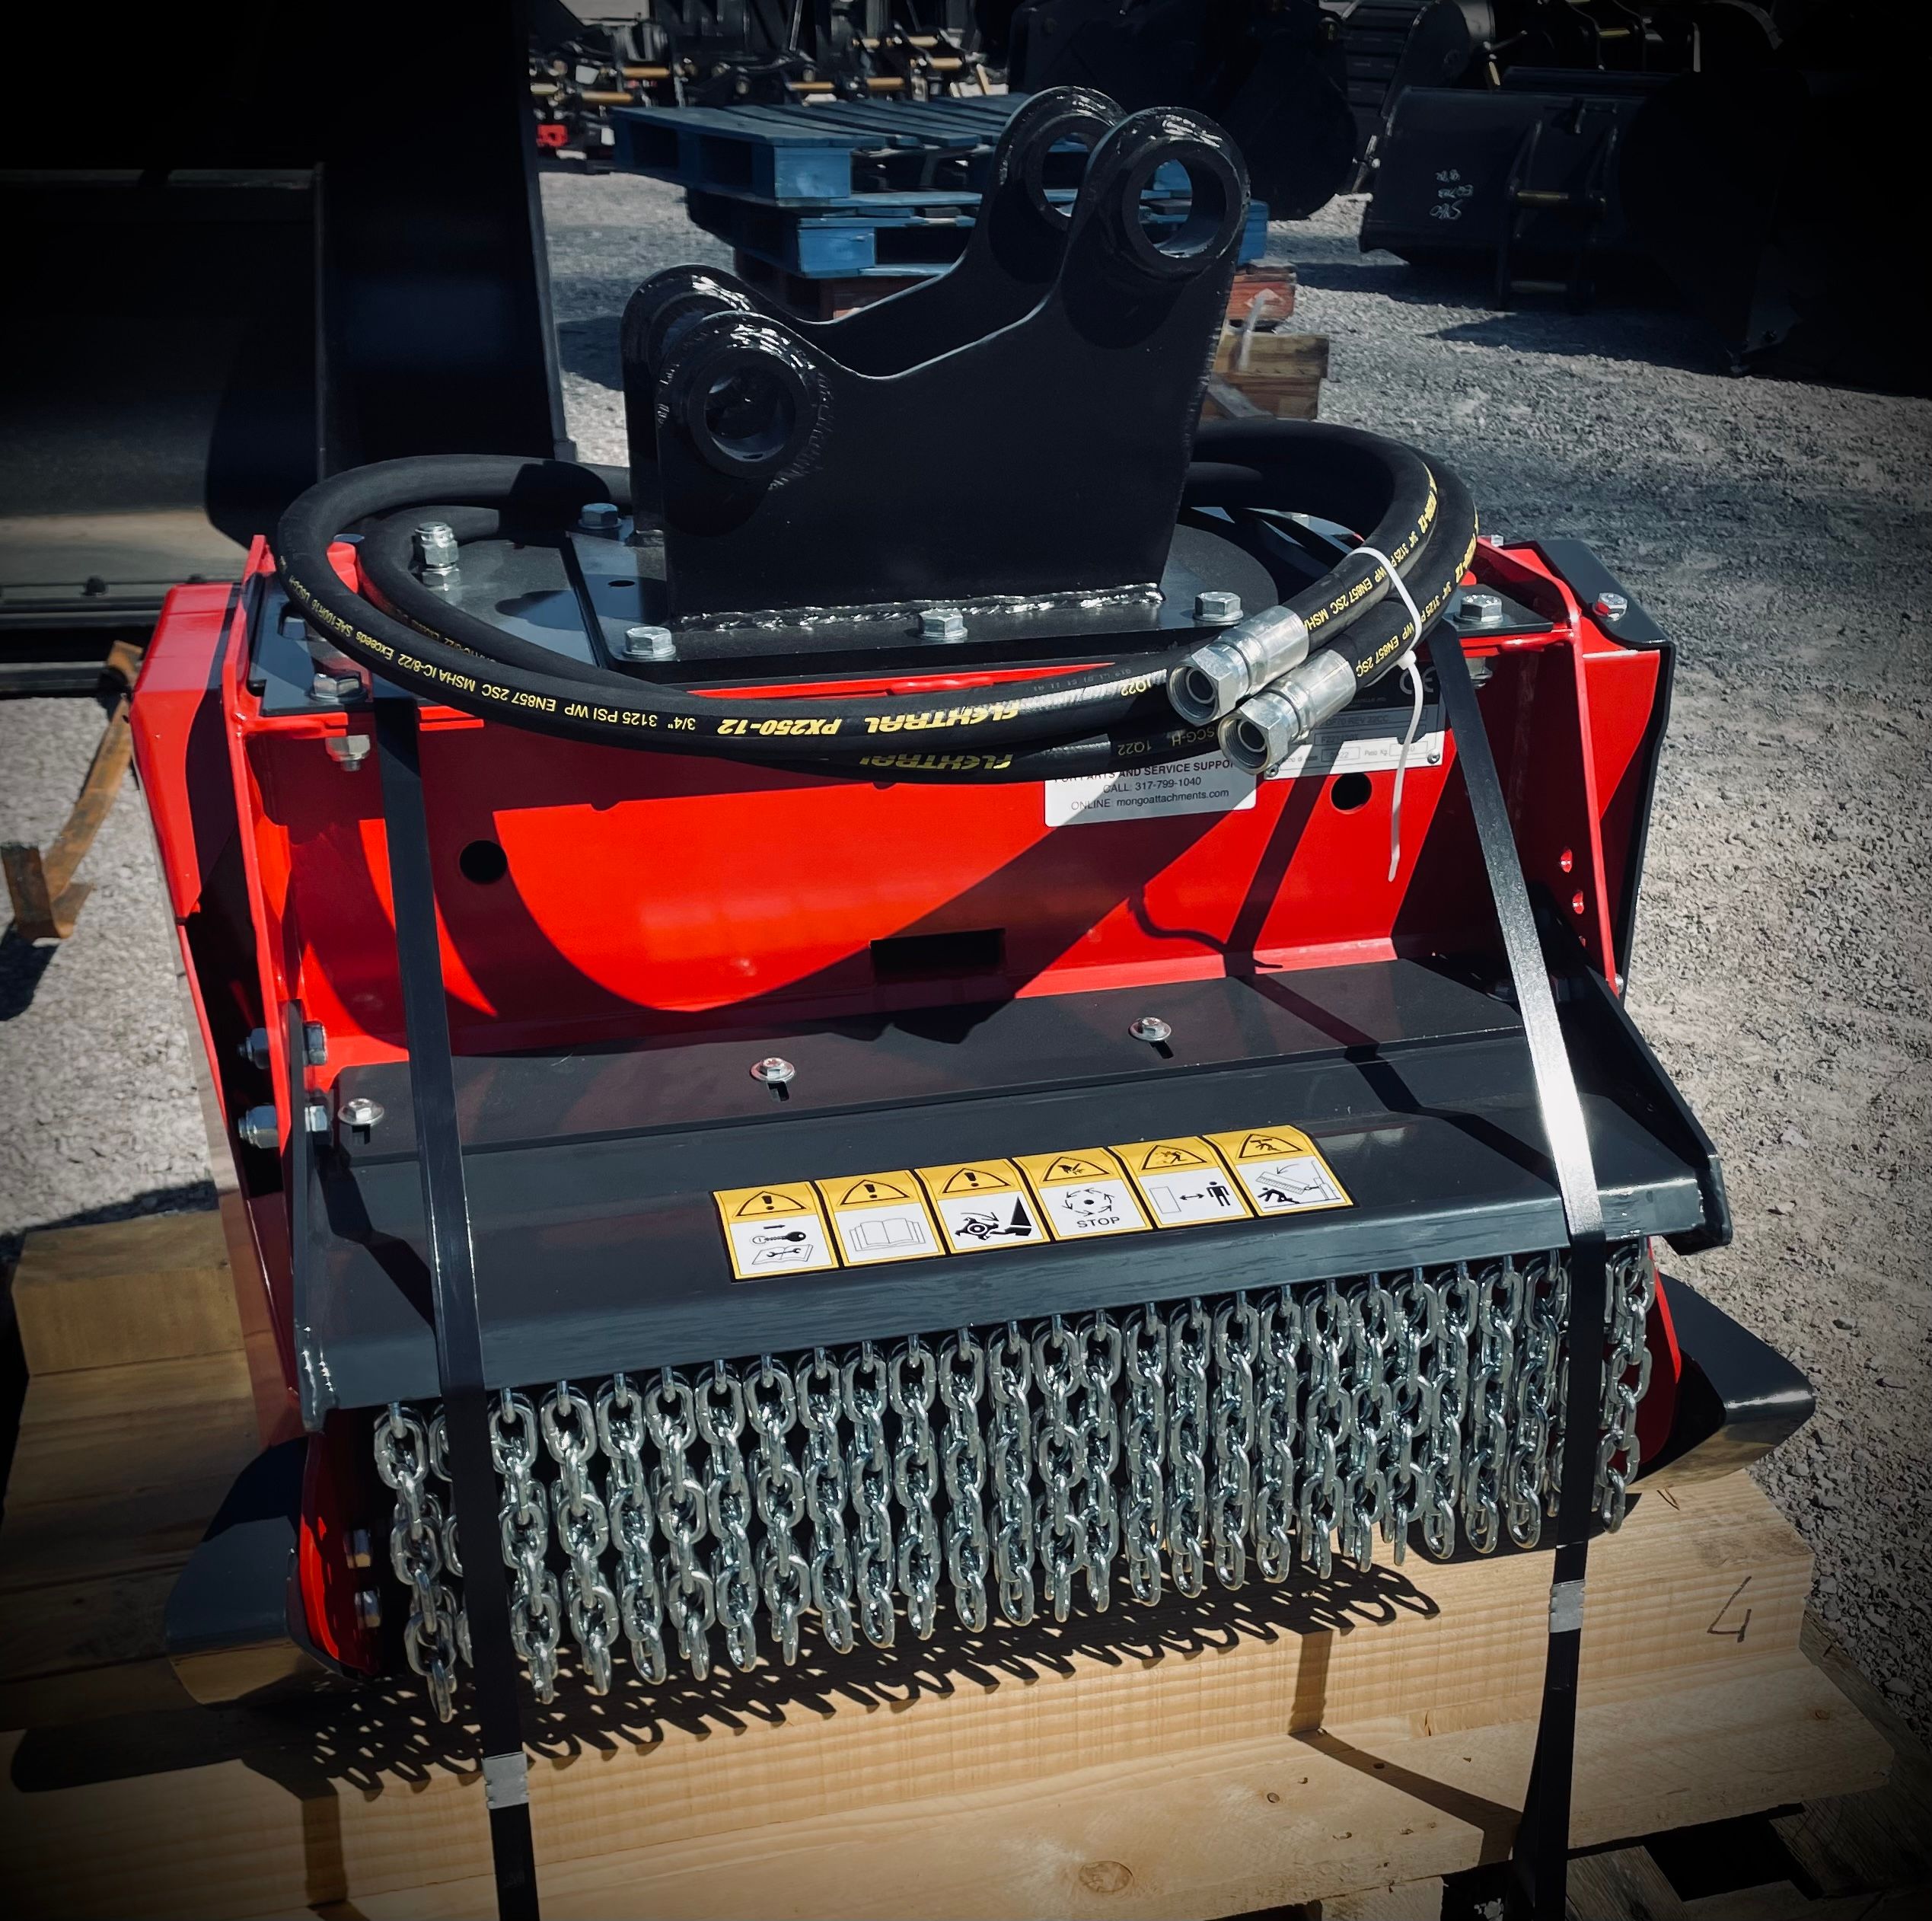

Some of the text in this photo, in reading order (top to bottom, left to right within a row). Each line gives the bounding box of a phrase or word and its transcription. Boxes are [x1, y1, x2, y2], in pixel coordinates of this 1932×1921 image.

[1349, 577, 1373, 600] EN857
[1329, 593, 1350, 614] 2SC
[355, 630, 395, 661] Exceeds
[1375, 635, 1400, 665] EN857
[397, 653, 438, 679] IC-8/22
[1355, 655, 1374, 678] 2SC
[438, 669, 477, 693] MSHA
[481, 683, 511, 701] 2SC
[511, 691, 557, 712] EN857
[564, 703, 589, 720] WP
[593, 707, 619, 724] PSI
[621, 711, 658, 727] 3125
[863, 699, 1021, 736] FLEXTRAL
[667, 716, 697, 731] 3/4"
[716, 717, 843, 736] PX250-12
[1172, 726, 1219, 748] SCG-H
[1117, 739, 1153, 756] 1Q22
[1118, 767, 1142, 778] AND
[1143, 761, 1191, 777] SERVICE
[1134, 777, 1203, 791] 317-799-1040
[1116, 789, 1230, 808] mongoattachments.com
[1076, 1216, 1121, 1228] STOP
[1707, 1575, 1752, 1644] 4
